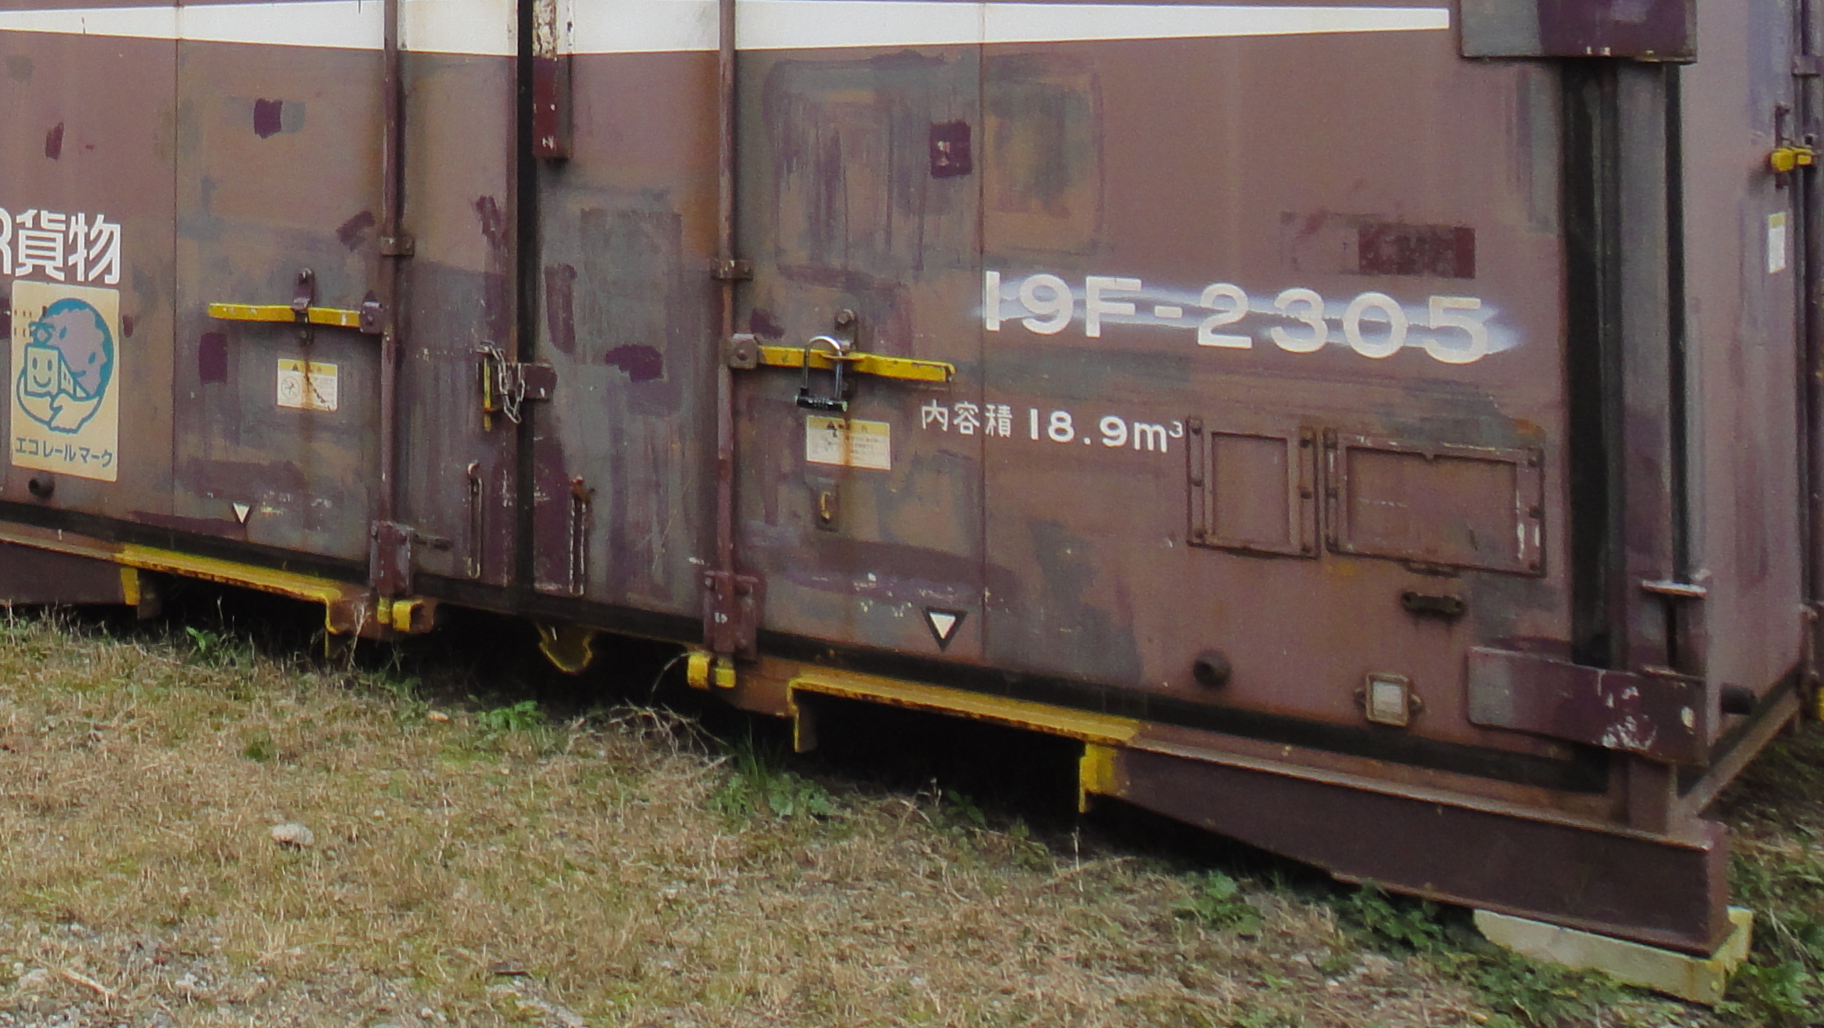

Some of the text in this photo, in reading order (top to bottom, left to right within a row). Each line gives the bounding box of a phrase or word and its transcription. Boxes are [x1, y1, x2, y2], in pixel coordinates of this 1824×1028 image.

[984, 270, 1489, 364] 19F-2305
[920, 399, 1013, 439] 内容積
[15, 435, 113, 468] エコレールマーク
